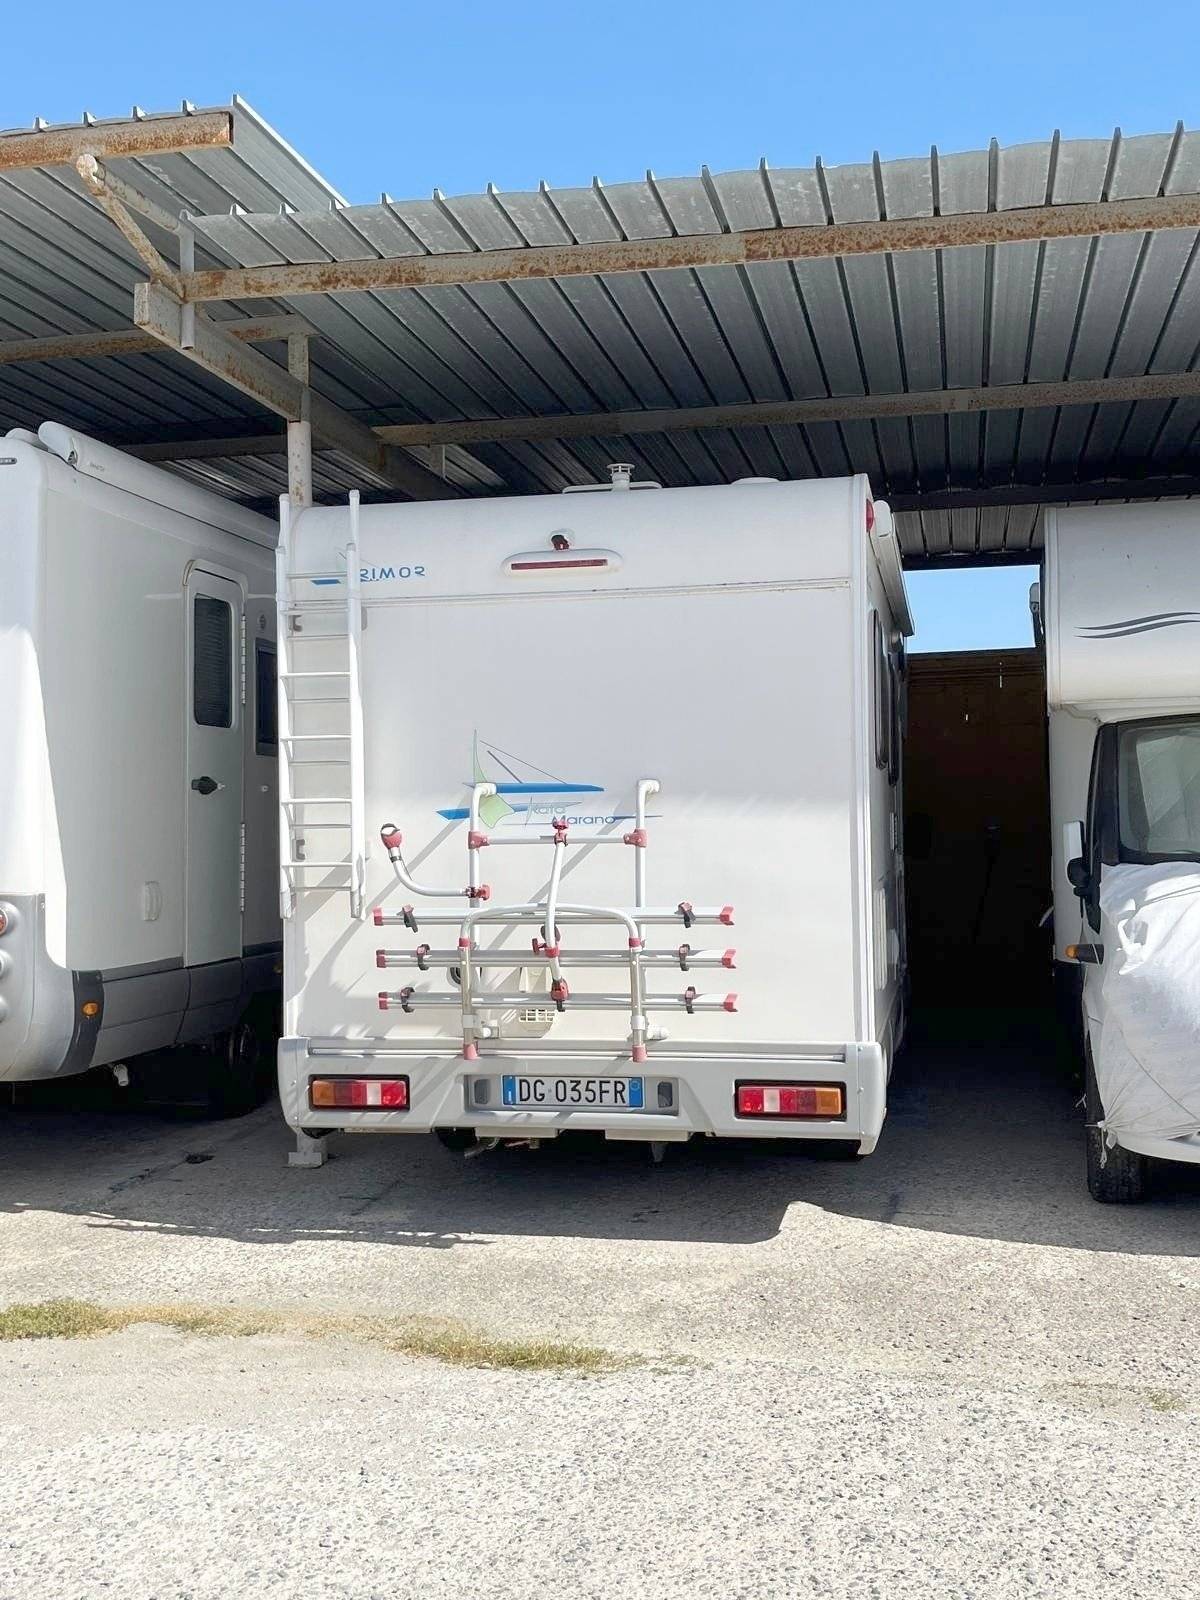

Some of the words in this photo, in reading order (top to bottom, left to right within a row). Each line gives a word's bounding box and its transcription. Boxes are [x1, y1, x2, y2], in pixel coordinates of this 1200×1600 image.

[359, 565, 426, 580] RIMOR
[518, 1078, 545, 1102] DG
[555, 1079, 627, 1104] 035FR
